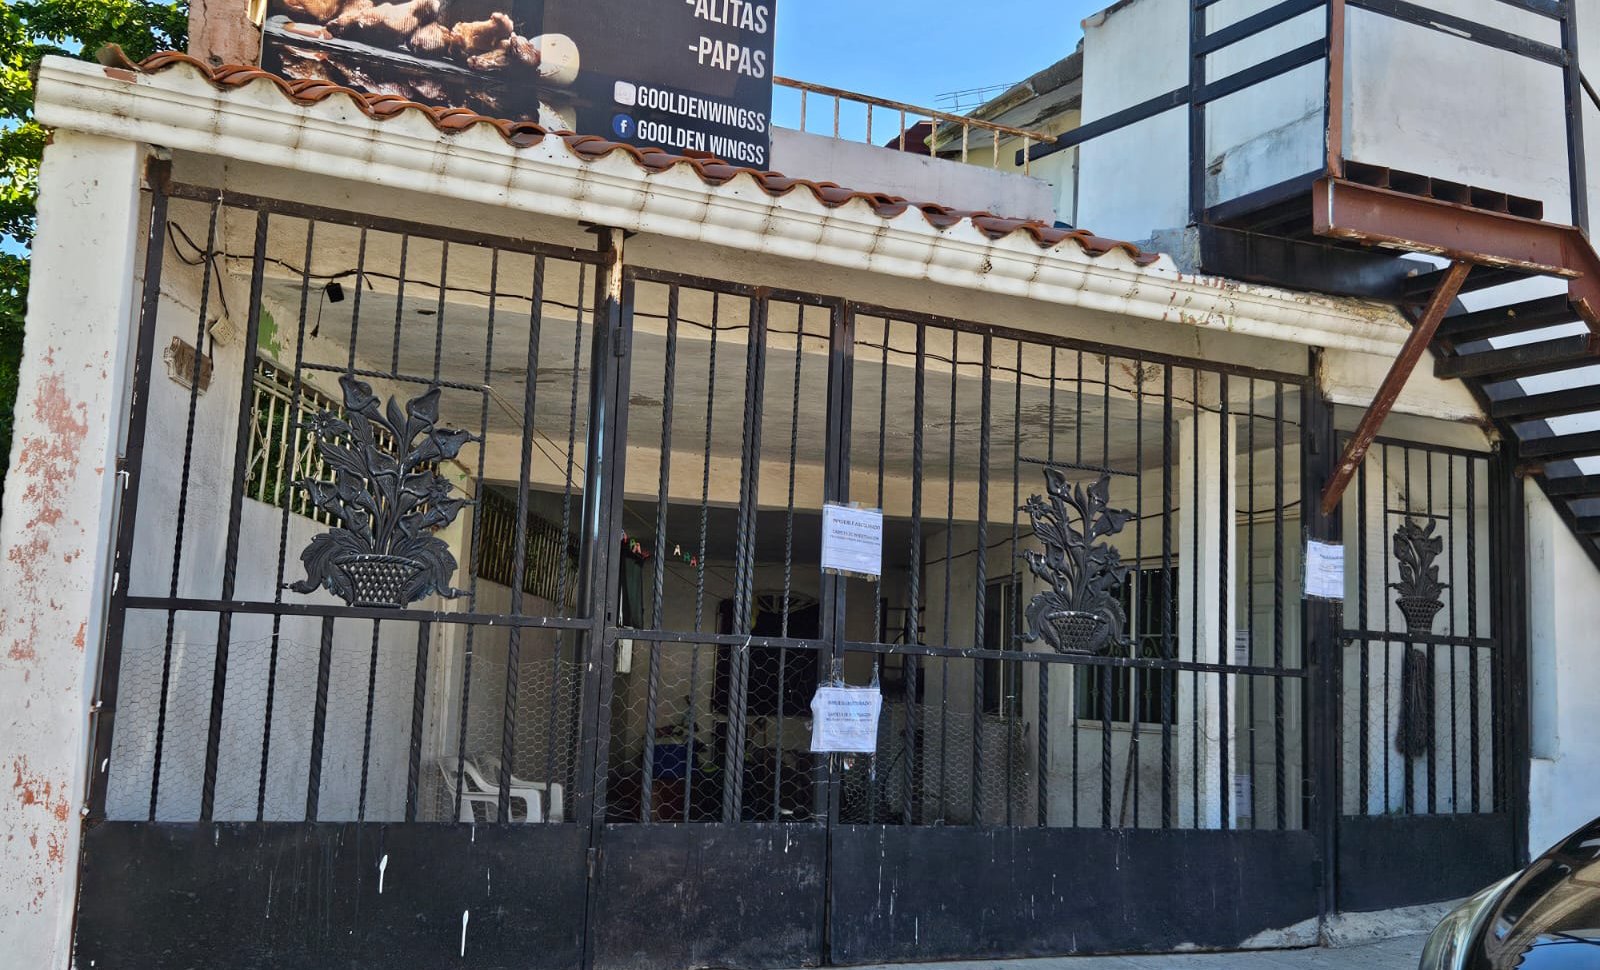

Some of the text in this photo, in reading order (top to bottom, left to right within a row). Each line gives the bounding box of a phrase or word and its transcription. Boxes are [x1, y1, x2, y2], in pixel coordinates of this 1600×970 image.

[686, 0, 768, 34] -ALITAS
[689, 36, 766, 78] -PAPAS
[637, 86, 766, 133] GOOLDENWINGSS
[637, 120, 705, 152] GOOLDEN
[709, 134, 765, 165] WINGSS
